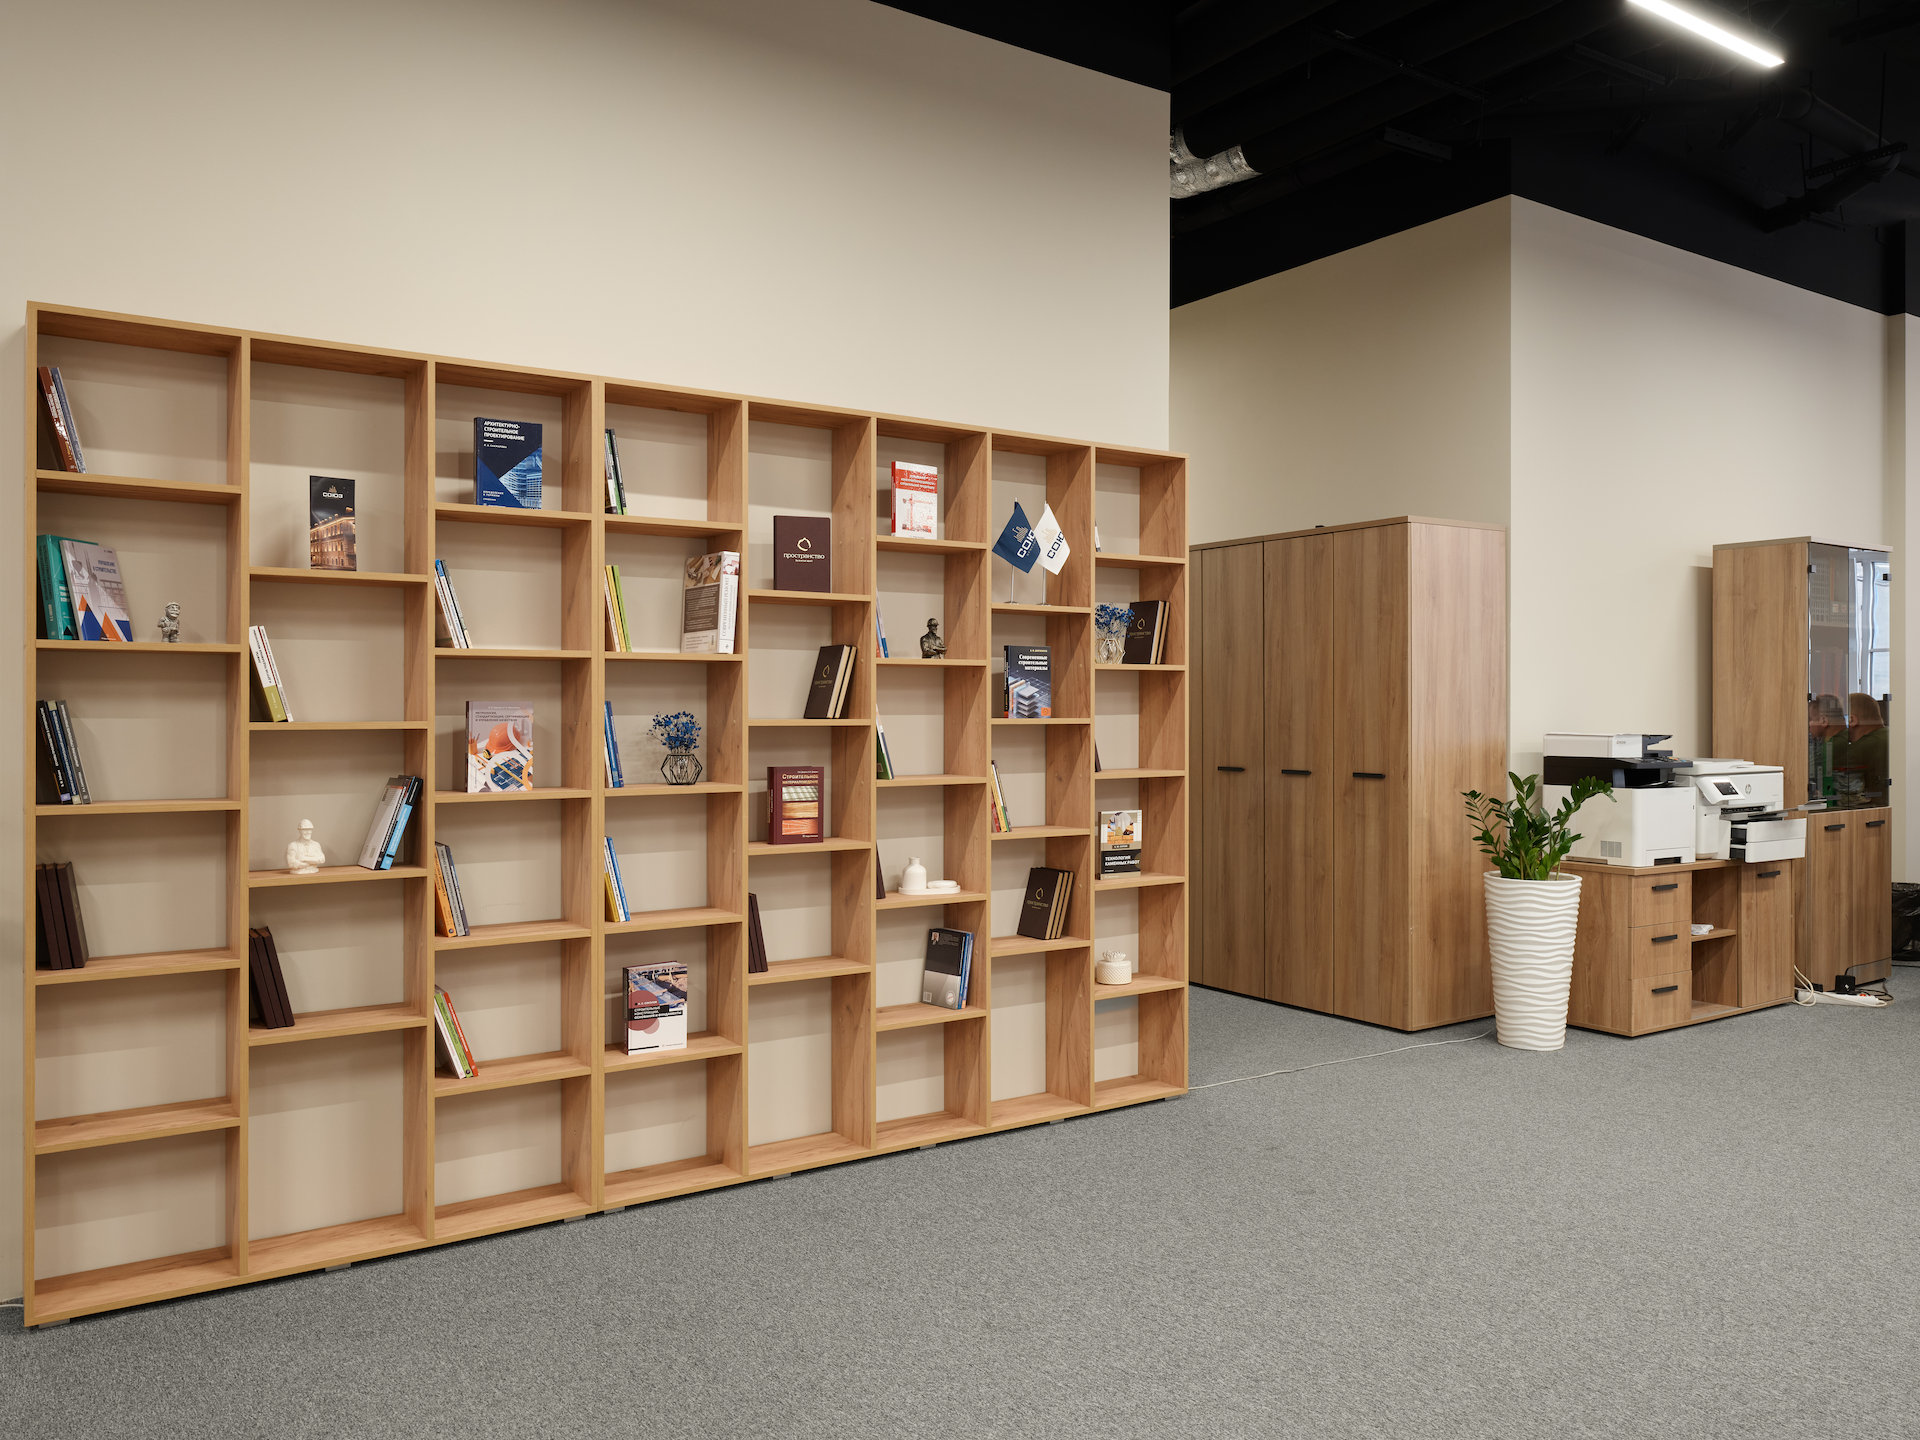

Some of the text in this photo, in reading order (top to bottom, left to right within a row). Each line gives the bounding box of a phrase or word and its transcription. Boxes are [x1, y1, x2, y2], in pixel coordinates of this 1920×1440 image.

[484, 421, 520, 429] АРХИТЕКТУРНО-
[484, 432, 525, 441] ПРОЕКТИРОВАНИЕ
[1017, 530, 1034, 558] СОЮ
[1047, 532, 1064, 559] СОЮ
